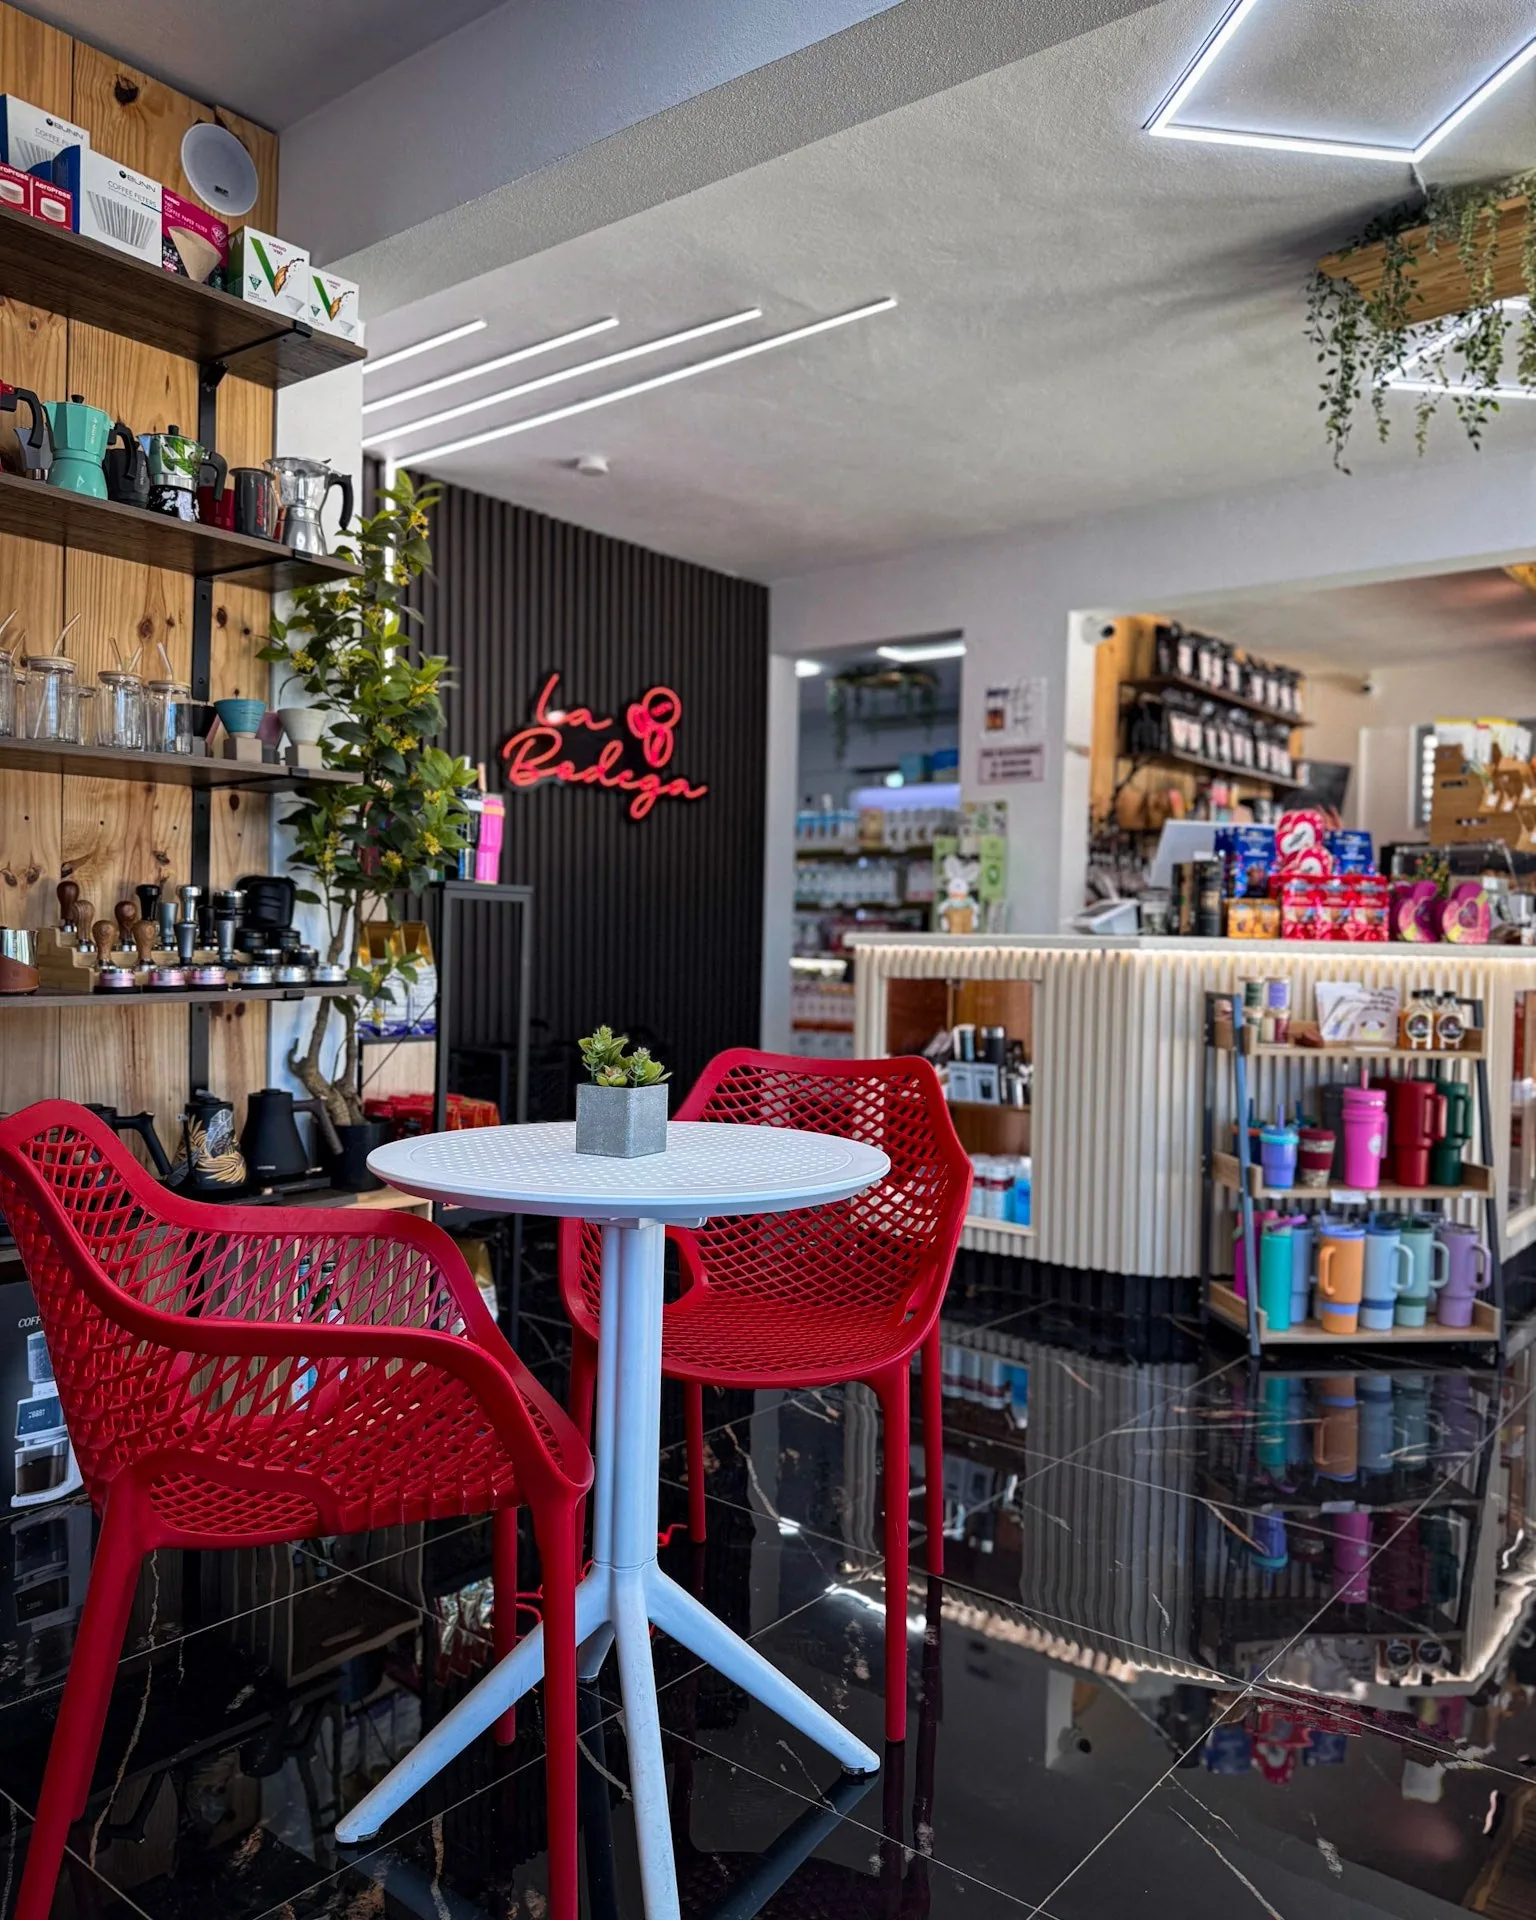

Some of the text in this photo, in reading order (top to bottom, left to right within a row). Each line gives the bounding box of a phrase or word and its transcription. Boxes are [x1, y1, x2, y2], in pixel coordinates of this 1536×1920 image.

[54, 122, 84, 140] BUNN
[35, 181, 71, 200] AeroPress
[107, 180, 133, 197] COFFEE
[127, 174, 156, 193] BUNN
[536, 673, 613, 731] La
[502, 726, 708, 820] Bodega
